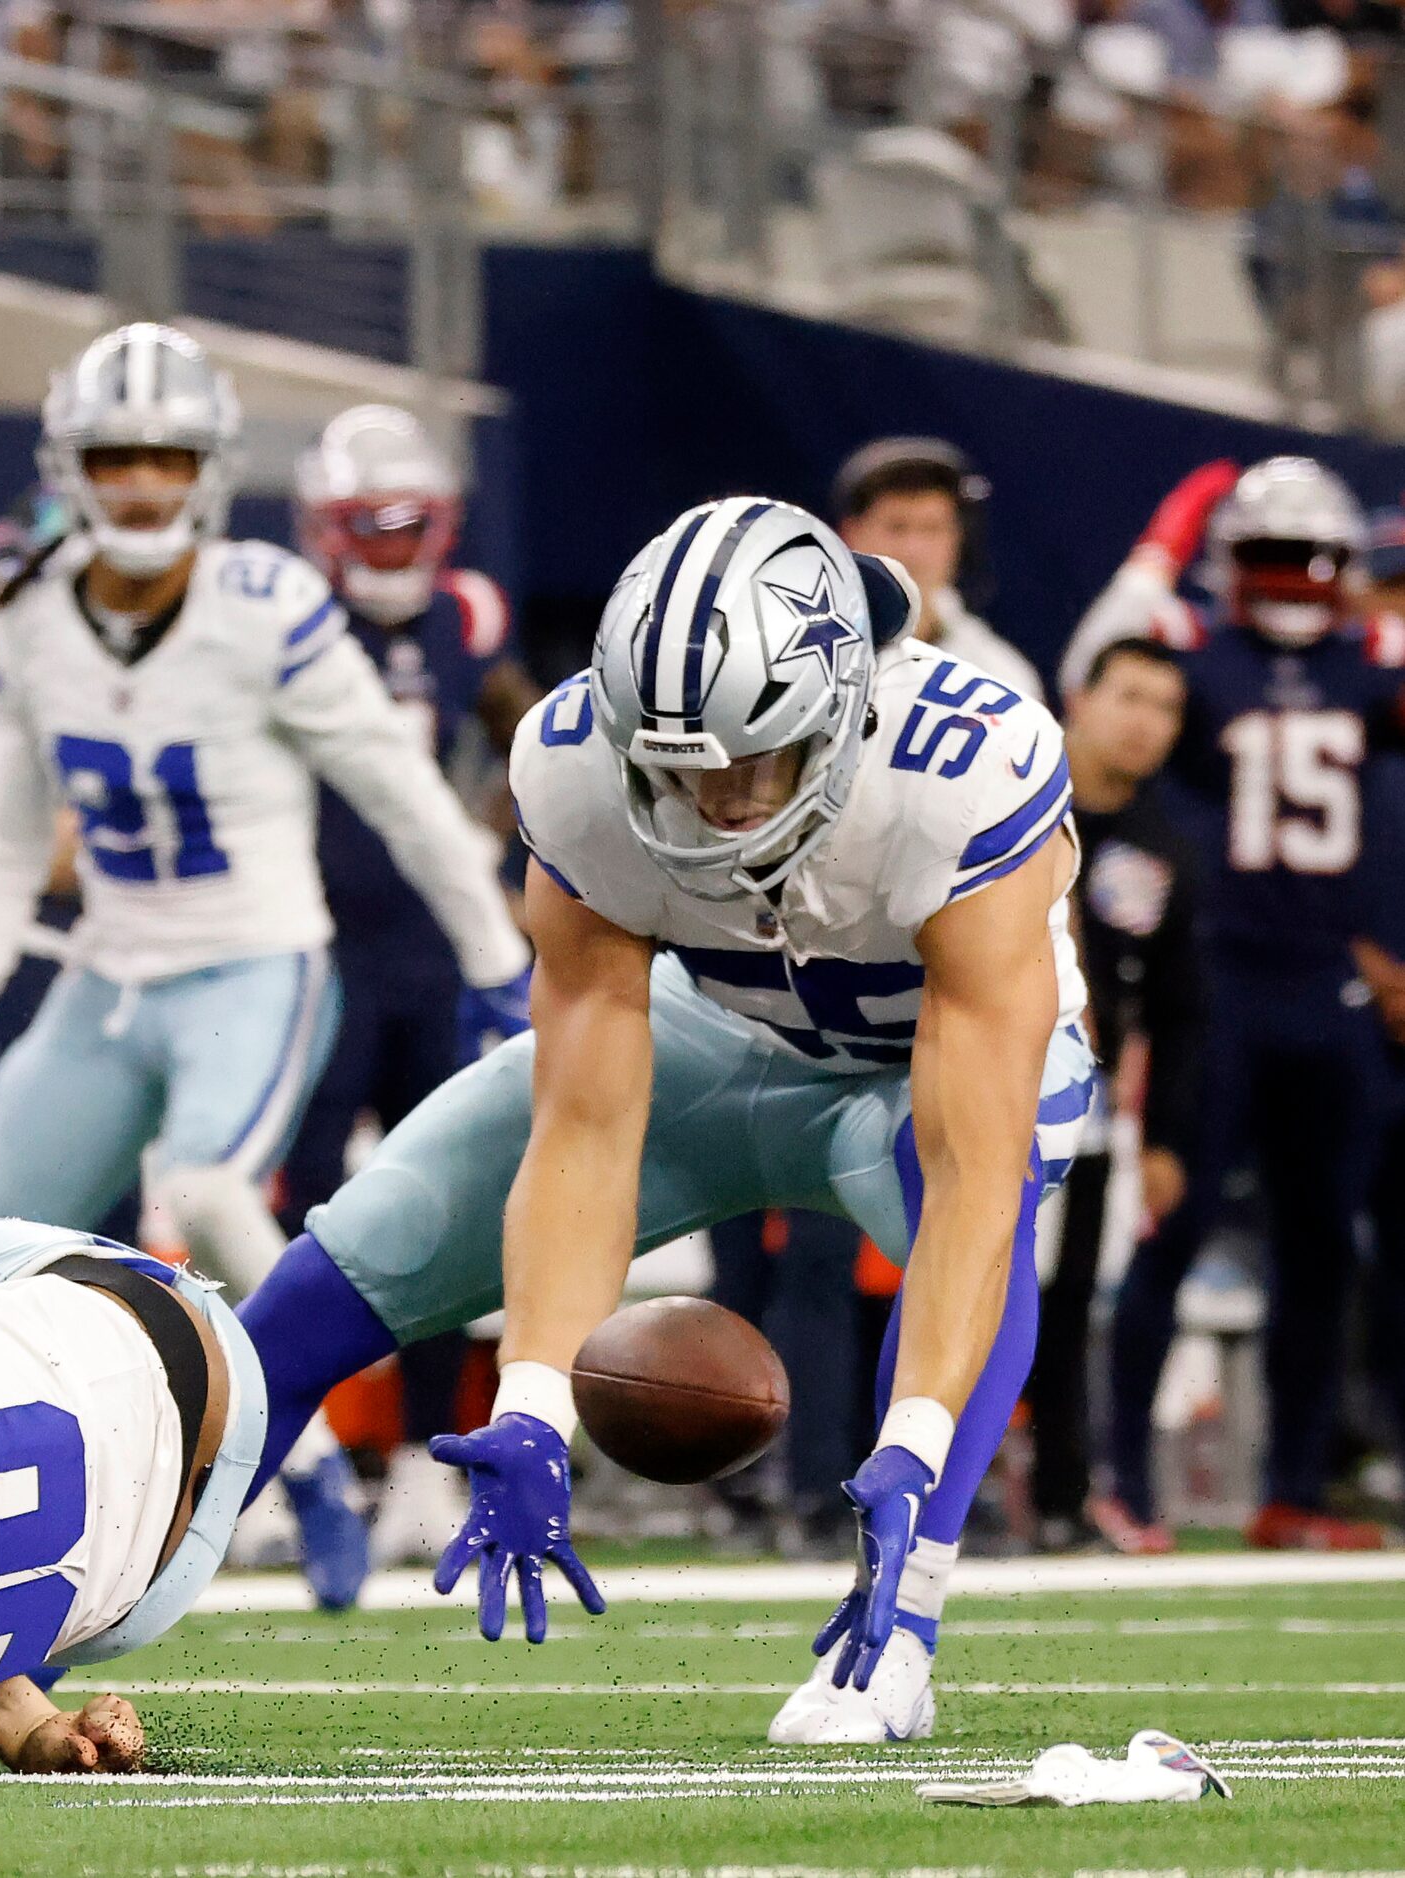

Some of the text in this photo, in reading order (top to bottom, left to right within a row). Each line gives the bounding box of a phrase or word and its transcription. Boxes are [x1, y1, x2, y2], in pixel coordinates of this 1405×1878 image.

[889, 660, 1022, 780] 55
[1217, 710, 1367, 875] 15
[56, 735, 229, 881] 21
